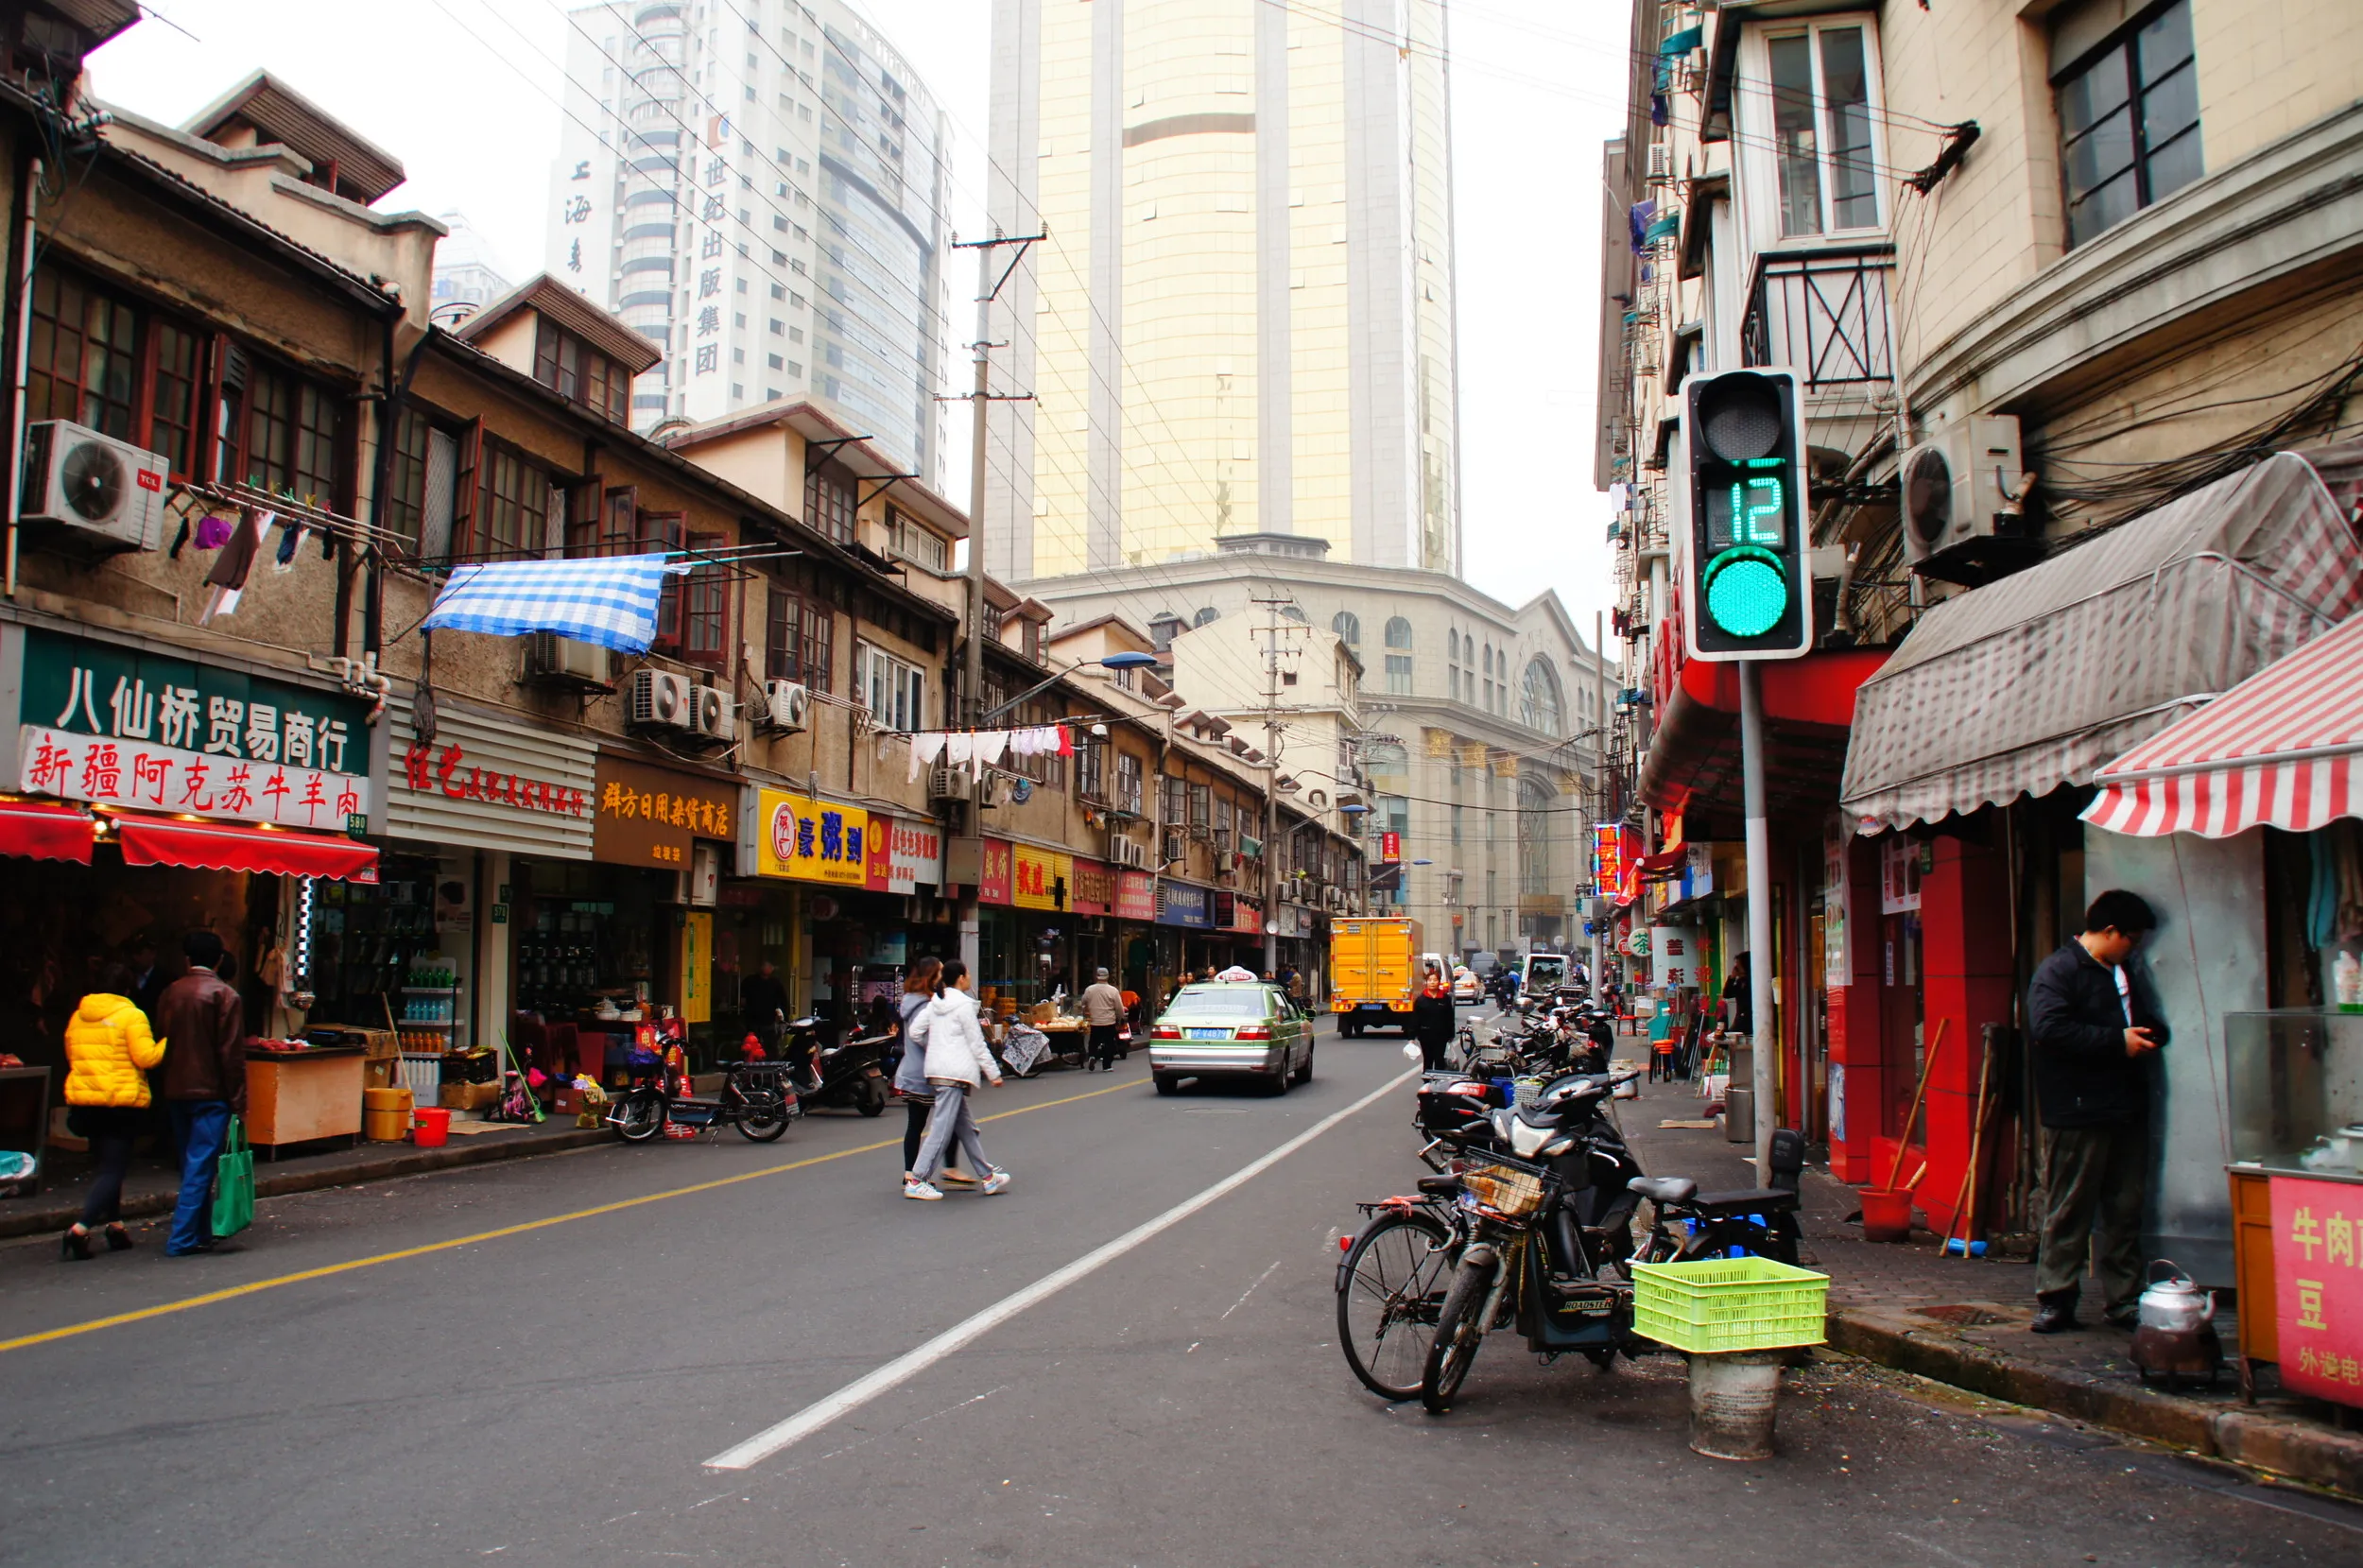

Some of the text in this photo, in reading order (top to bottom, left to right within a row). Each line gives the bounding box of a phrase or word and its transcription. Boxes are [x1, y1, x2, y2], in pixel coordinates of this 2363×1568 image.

[695, 155, 730, 377] 世纪出版集团
[140, 473, 159, 489] TCL
[1732, 477, 1781, 542] 12
[57, 666, 348, 772] 八仙桥贸易商行
[28, 732, 360, 826] 新疆阿克苏牛羊肉
[349, 816, 366, 829] 580
[601, 782, 730, 836] 群方日用杂货商店
[1633, 932, 1650, 955] 茶
[2291, 1205, 2363, 1269] 牛肉
[2295, 1278, 2328, 1332] 豆
[2299, 1346, 2363, 1387] 外送电
